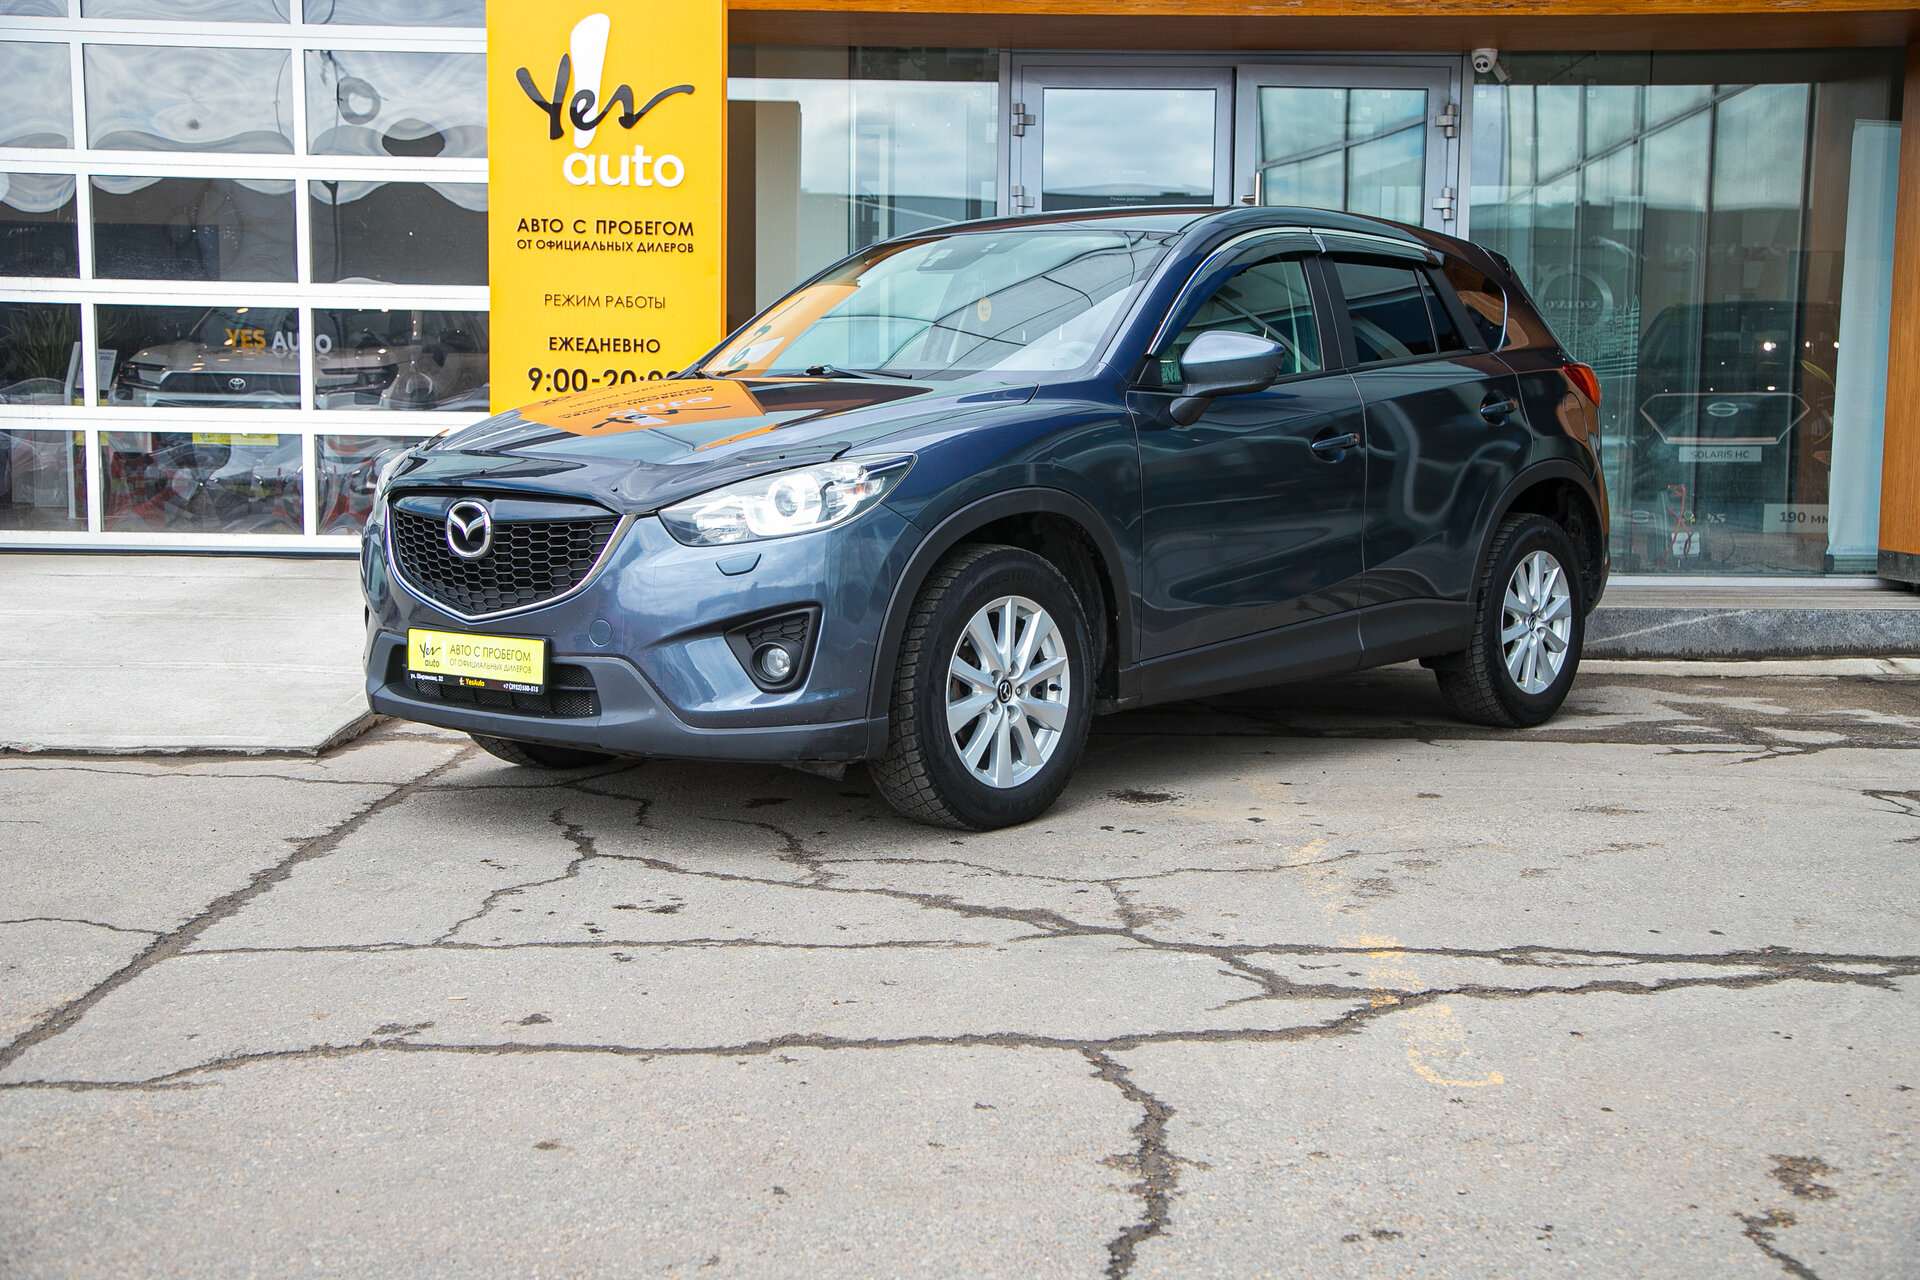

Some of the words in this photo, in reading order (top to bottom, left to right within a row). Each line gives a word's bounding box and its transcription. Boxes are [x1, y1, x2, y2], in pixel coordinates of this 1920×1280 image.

[515, 53, 695, 140] Yes
[563, 144, 685, 188] auto
[517, 217, 564, 234] АВТО
[573, 219, 587, 234] С
[595, 219, 694, 237] ПРОБЕГОМ
[516, 239, 532, 251] ОТ
[536, 239, 634, 254] ОФИЦИАЛЬНЫХ
[637, 241, 694, 254] ДИЛЕРОВ
[544, 293, 601, 308] РЕЖИМ
[605, 294, 666, 309] РАБОТЫ
[225, 328, 266, 348] YES
[272, 331, 332, 354] AUO
[548, 336, 661, 354] ЕЖЕДНЕВНО
[528, 367, 679, 393] 9:00-20:
[1691, 450, 1733, 460] SOLARIS
[1735, 450, 1750, 460] HC
[1779, 511, 1806, 523] 190
[450, 644, 472, 656] АВТО
[473, 647, 480, 657] С
[482, 647, 531, 662] ПРОБЕГОМ
[425, 659, 440, 668] auto
[449, 659, 457, 667] ОТ
[458, 660, 502, 671] ОФИЦИАЛЬНЫХ
[503, 664, 531, 674] ДИЛЕРОВ
